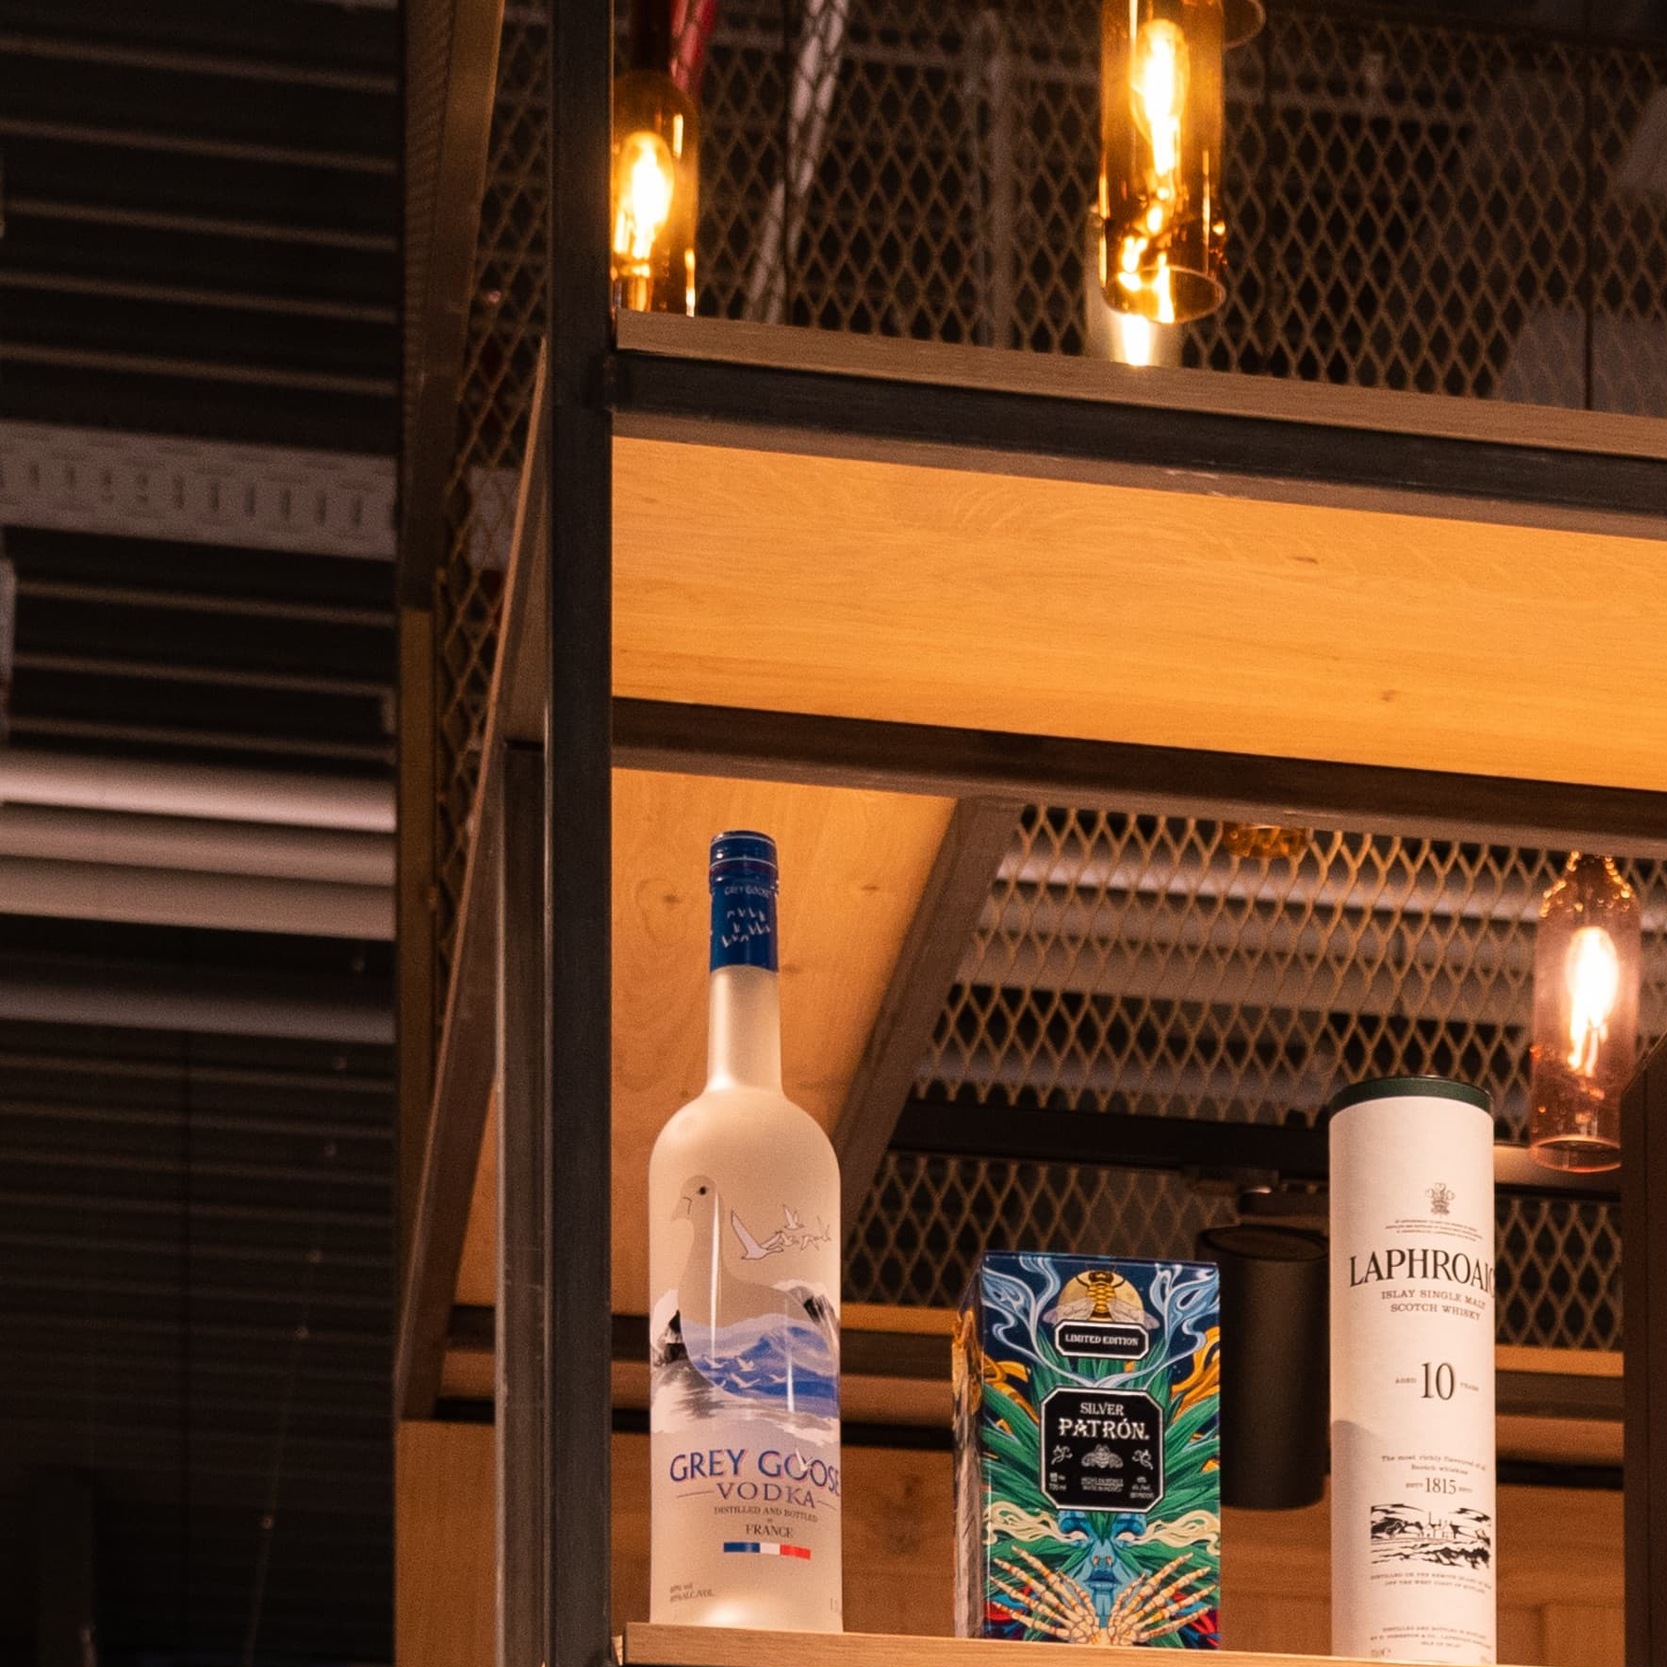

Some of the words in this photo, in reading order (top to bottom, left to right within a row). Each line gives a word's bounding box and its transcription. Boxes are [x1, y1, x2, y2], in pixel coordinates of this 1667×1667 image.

[1381, 1289, 1416, 1300] ISLAY
[1420, 1290, 1462, 1302] SINGLE
[1390, 1303, 1438, 1313] SCOTCH
[1442, 1305, 1481, 1321] WHISKY
[1064, 1333, 1102, 1345] LIMITED
[1102, 1335, 1139, 1347] EDITION
[1420, 1361, 1455, 1401] 10
[1080, 1402, 1125, 1417] SILVER
[669, 1449, 746, 1483] GREY
[1424, 1477, 1457, 1495] 1815
[716, 1482, 817, 1510] VODKA
[745, 1523, 794, 1539] FRANCE
